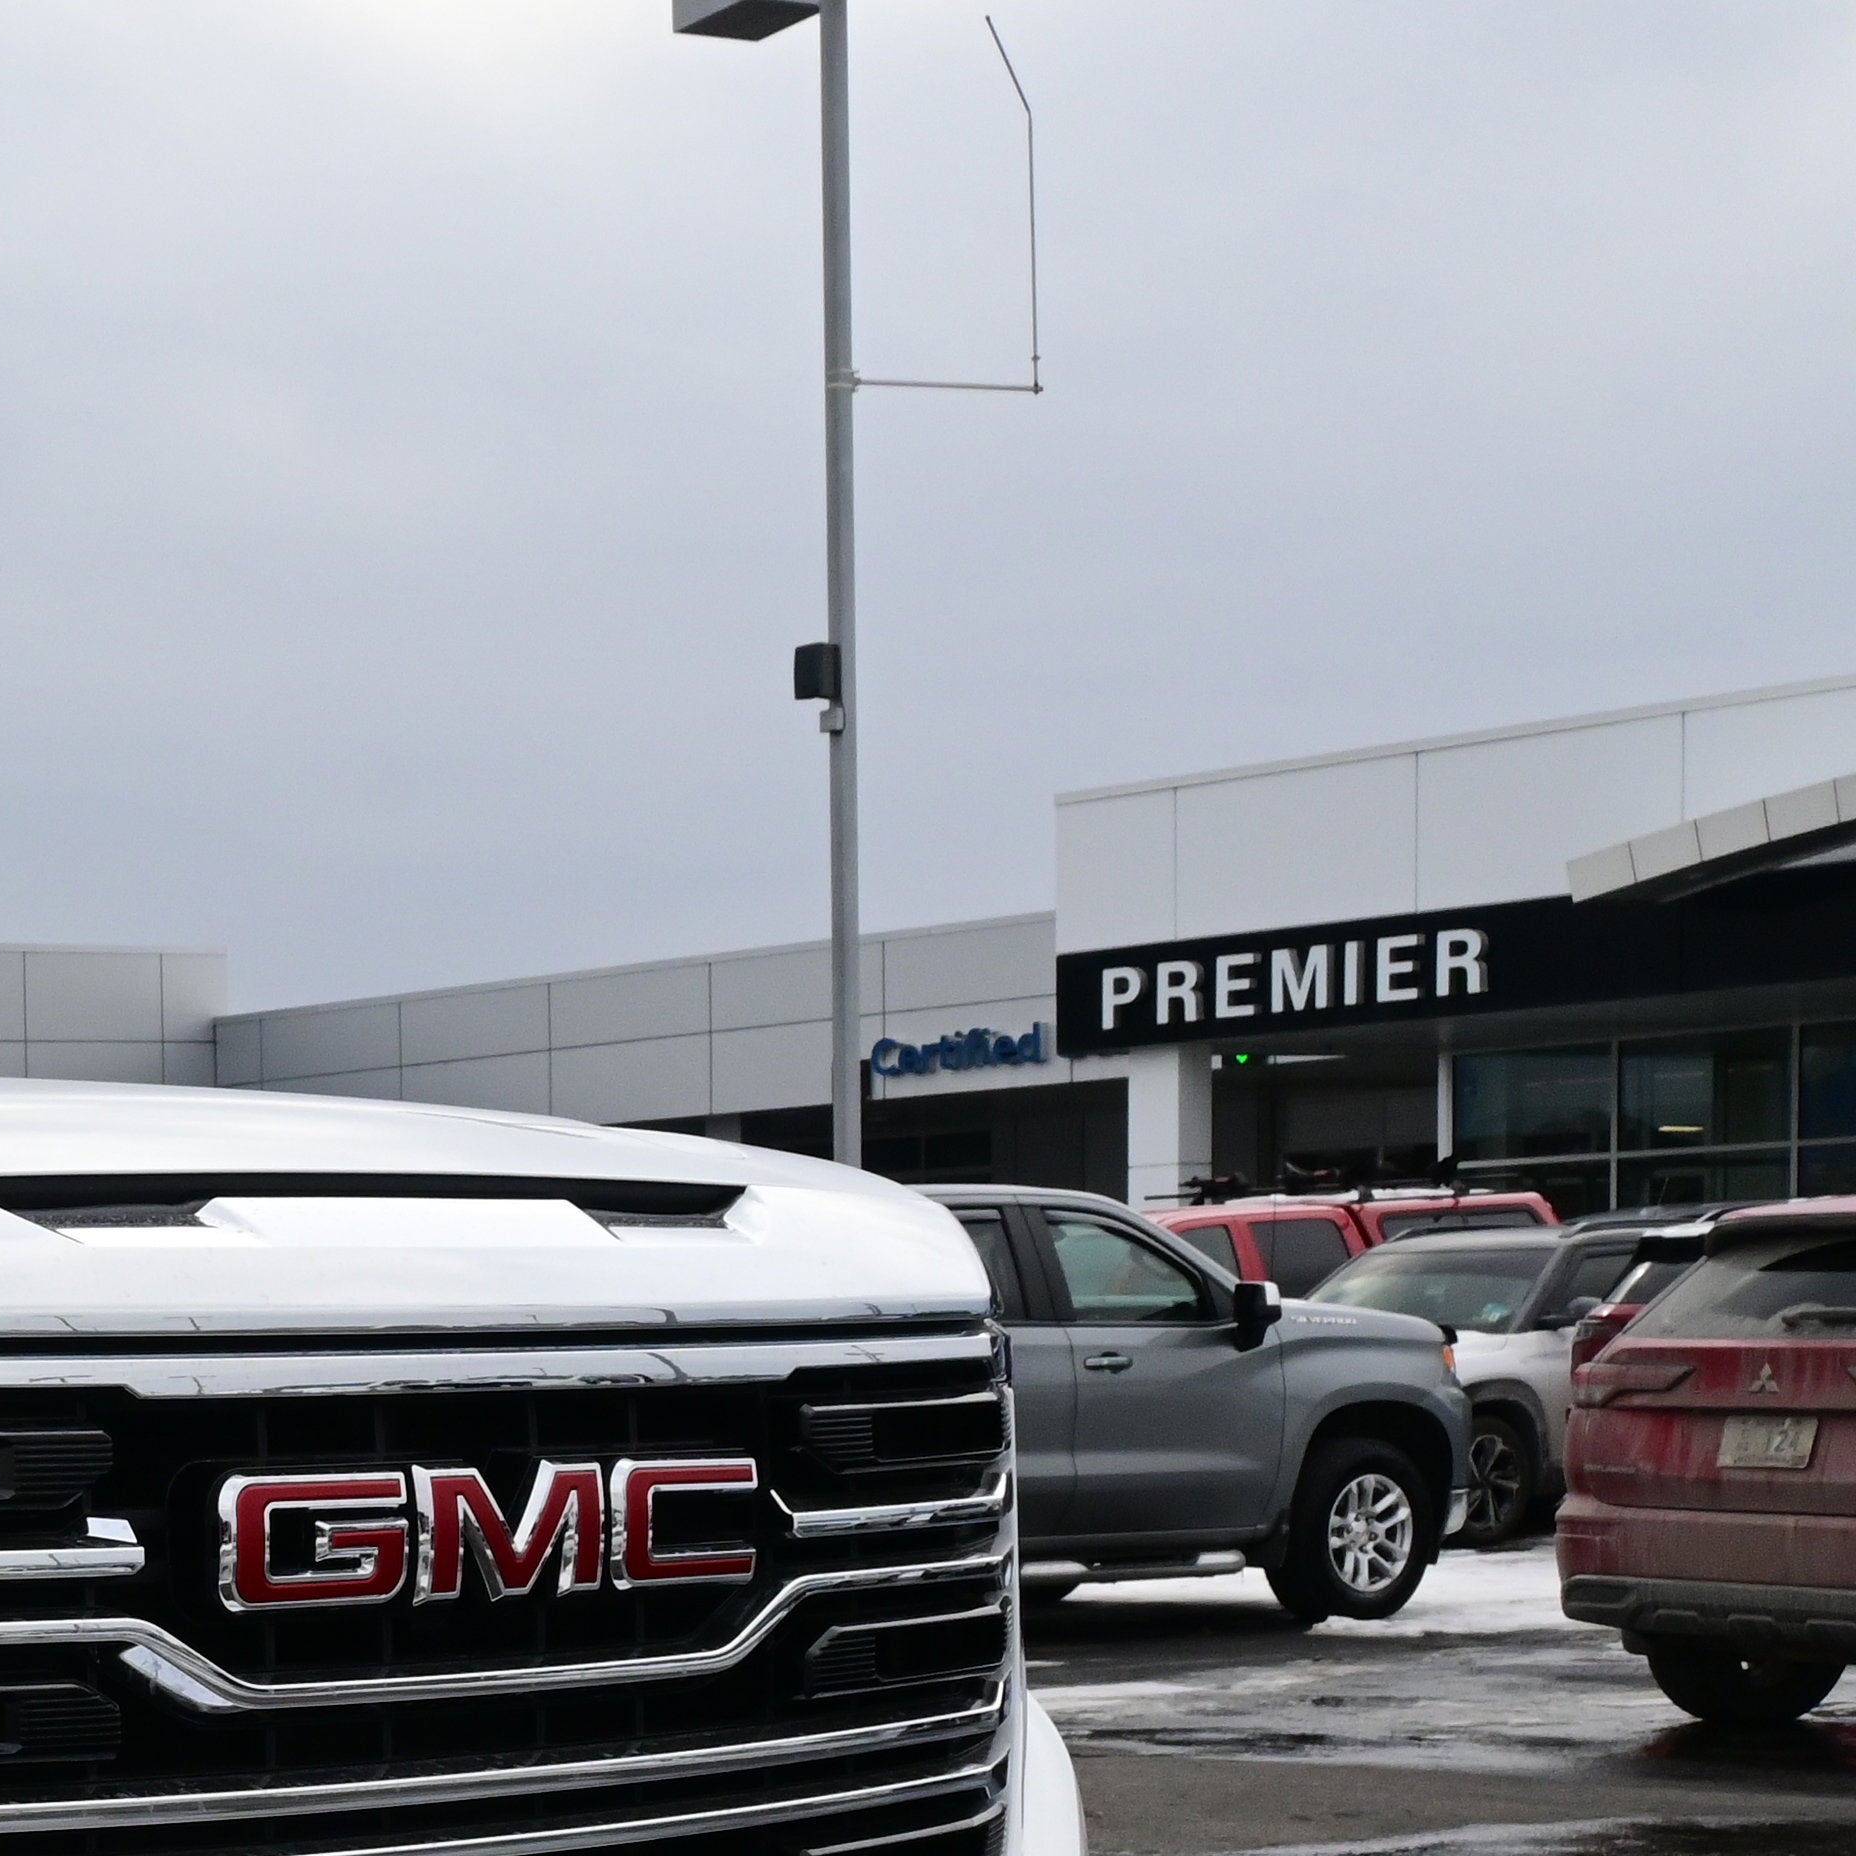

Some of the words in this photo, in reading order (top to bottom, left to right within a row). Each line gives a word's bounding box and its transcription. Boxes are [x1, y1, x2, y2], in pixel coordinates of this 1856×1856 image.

[1102, 928, 1488, 1030] PREMIER
[872, 1021, 1044, 1076] Certified
[218, 1458, 758, 1612] GMC
